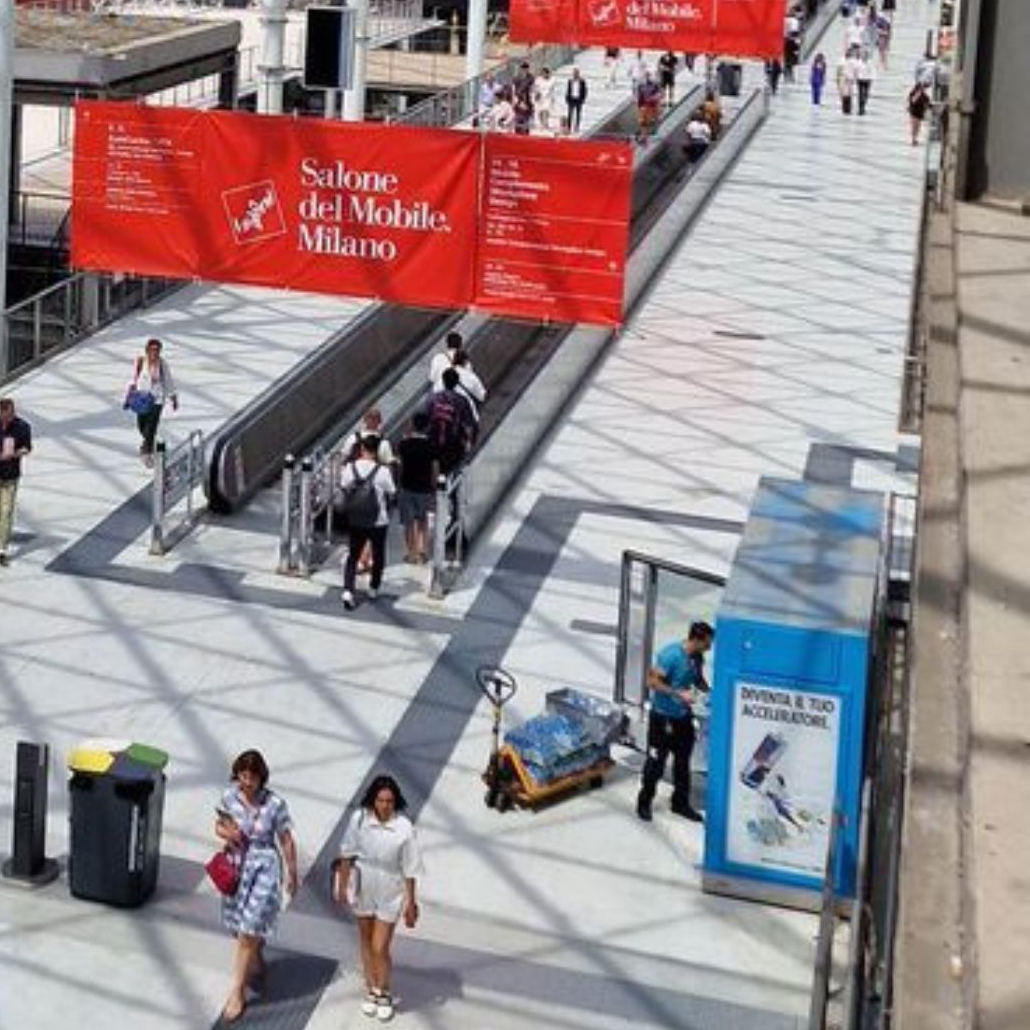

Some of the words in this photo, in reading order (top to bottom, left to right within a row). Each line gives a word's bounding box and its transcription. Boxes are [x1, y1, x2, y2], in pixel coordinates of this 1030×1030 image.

[626, 0, 650, 15] del
[625, 16, 675, 32] Milano
[301, 157, 398, 194] Salone
[298, 191, 342, 221] del
[297, 224, 398, 262] Milano
[741, 687, 791, 706] DIVENTA
[809, 697, 835, 713] TUO
